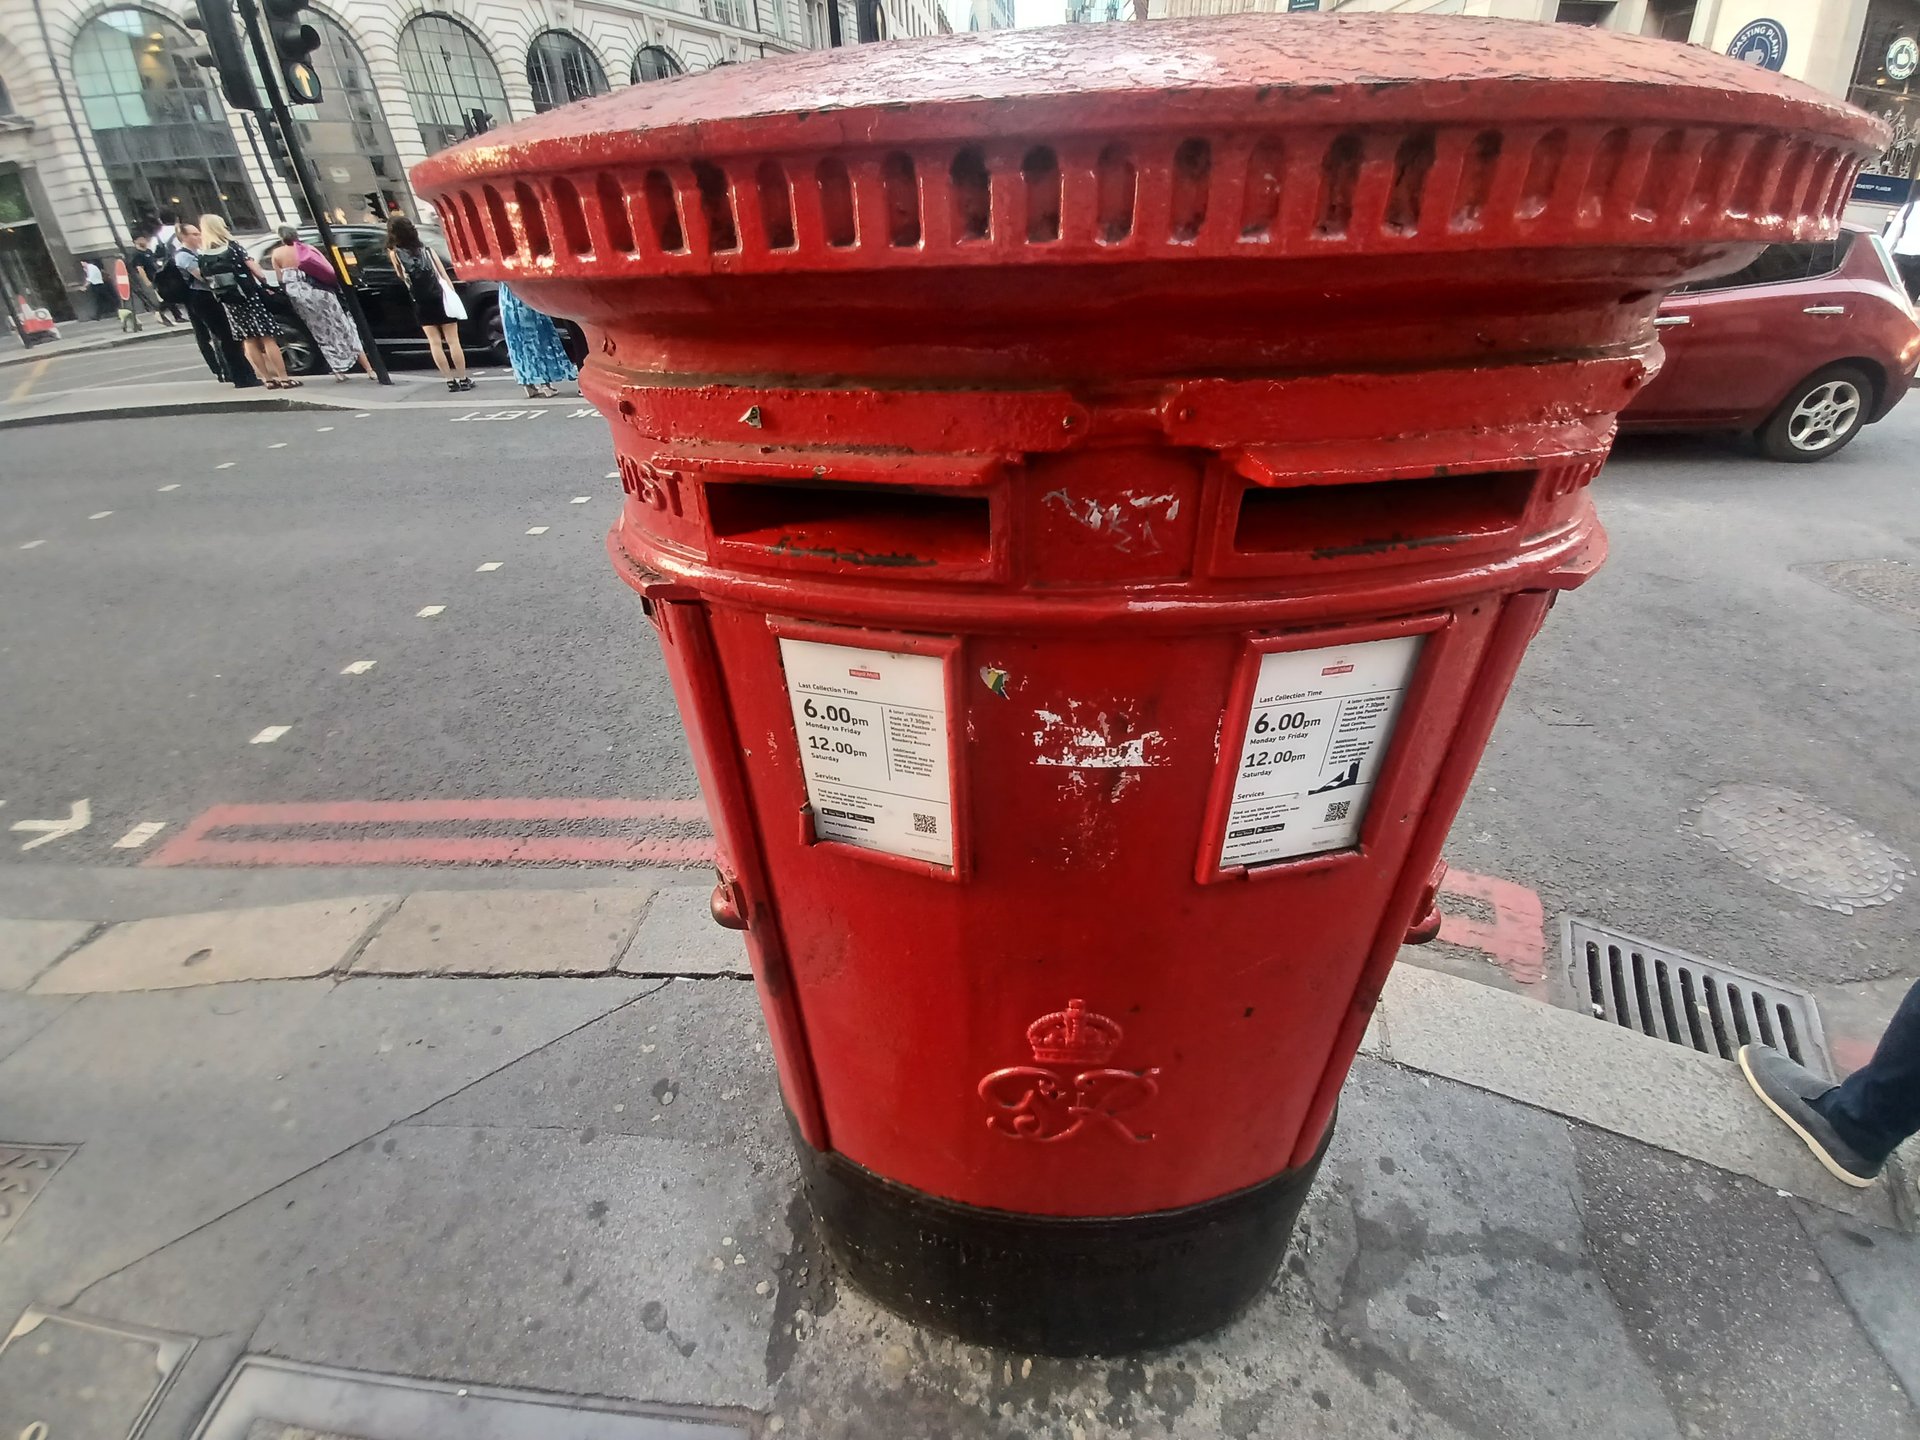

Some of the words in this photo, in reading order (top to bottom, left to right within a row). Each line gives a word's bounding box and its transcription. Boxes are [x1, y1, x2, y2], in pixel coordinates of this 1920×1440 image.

[1766, 28, 1779, 60] PLANT
[450, 409, 549, 422] LEFT
[812, 684, 841, 693] Collection
[1259, 695, 1274, 703] Last
[1275, 692, 1306, 701] Collection
[804, 699, 869, 727] 6.00pm
[805, 721, 830, 731] Monday
[840, 726, 861, 736] Friday
[1254, 711, 1321, 734] 6.00pm
[1250, 736, 1276, 745] Monday
[1287, 731, 1309, 740] Friday
[808, 736, 868, 758] 12.00pm
[811, 753, 839, 763] Saturday
[1244, 750, 1306, 768] 12.00pm
[815, 772, 841, 782] Services
[1242, 769, 1272, 779] Saturday
[1237, 791, 1265, 800] Services
